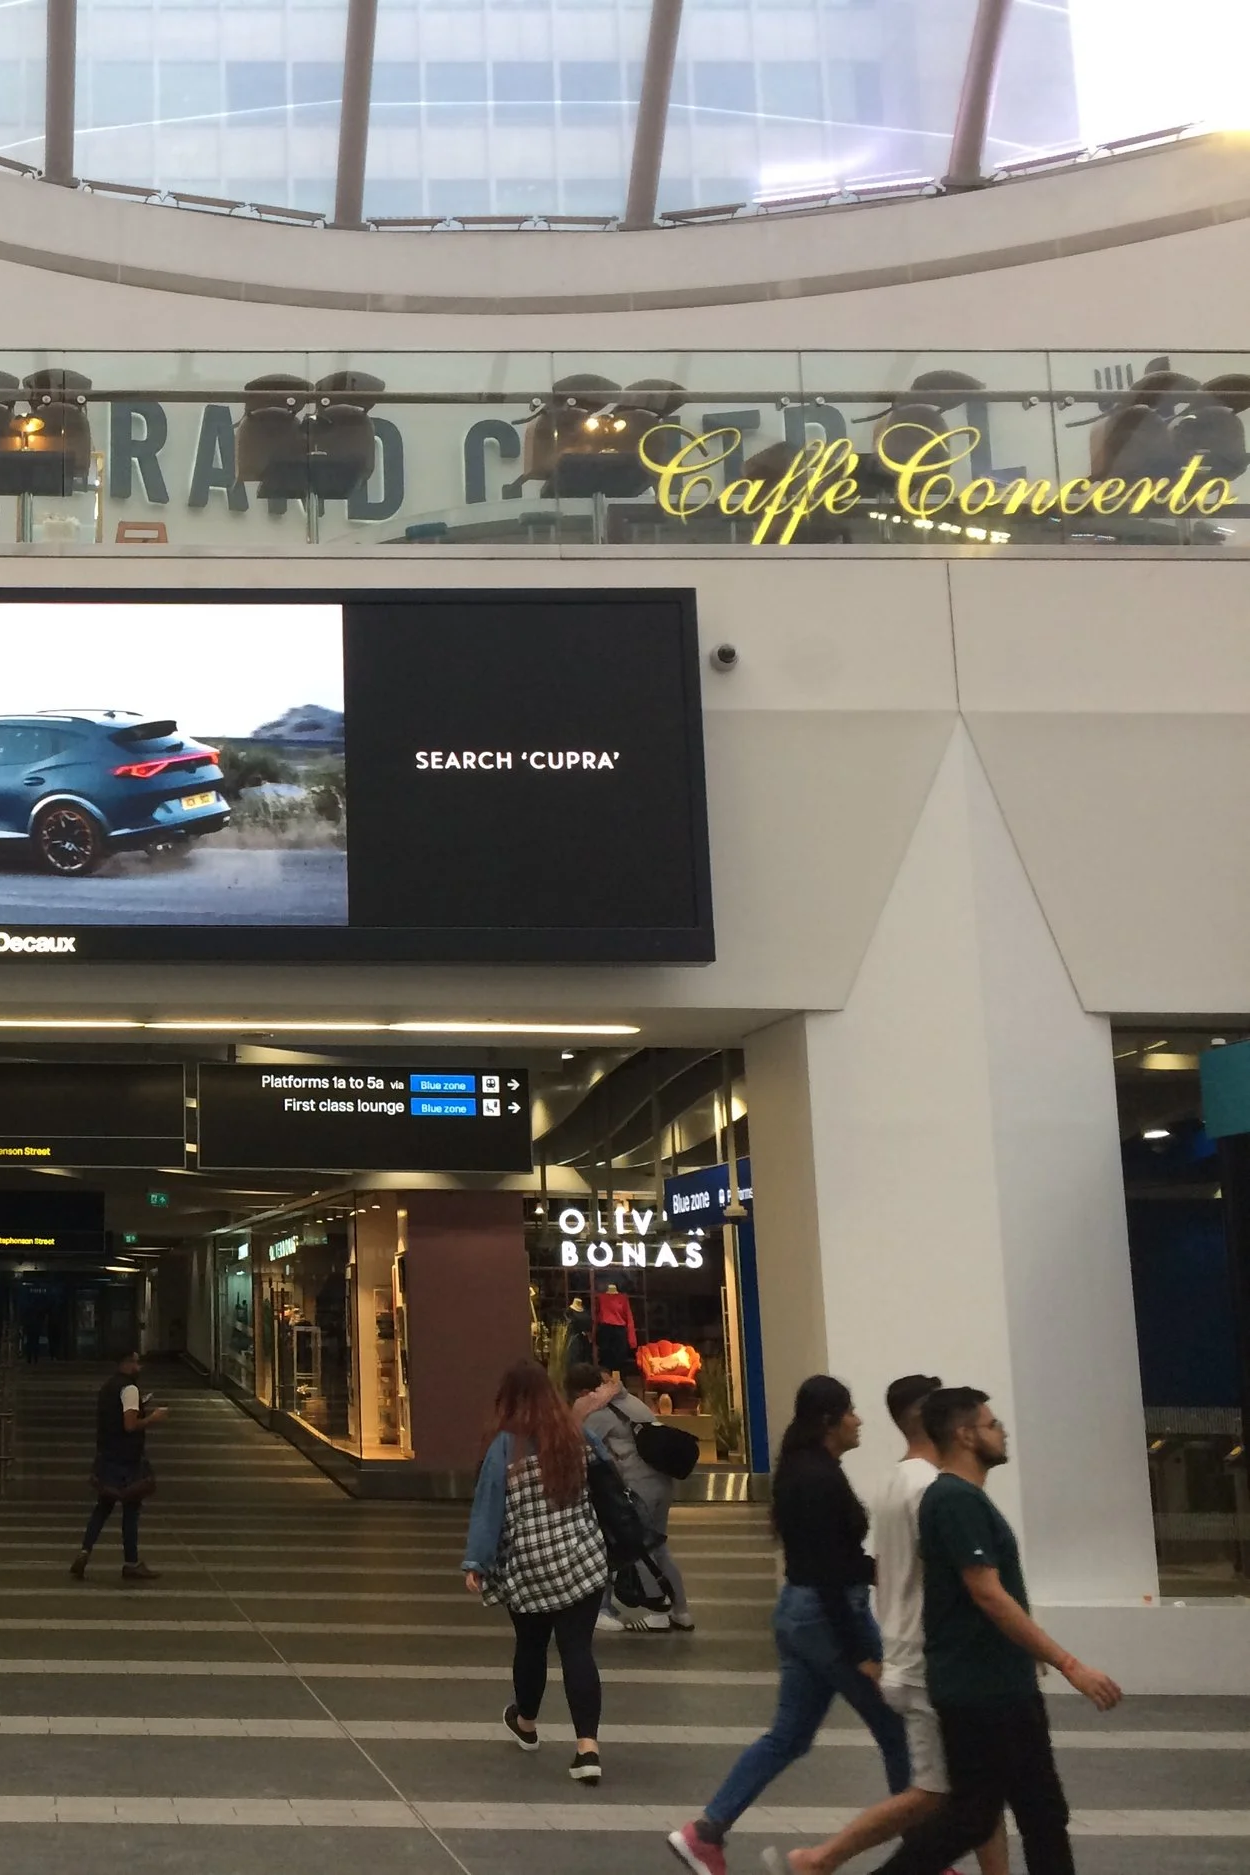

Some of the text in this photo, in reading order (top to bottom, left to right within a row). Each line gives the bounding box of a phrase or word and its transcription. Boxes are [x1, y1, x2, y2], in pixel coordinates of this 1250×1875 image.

[877, 422, 1239, 521] Concerto
[415, 751, 512, 770] SEARCH
[261, 1074, 405, 1091] Platforms 1a to 5a via
[420, 1080, 467, 1091] Blue zone
[284, 1098, 405, 1115] First class lounge
[421, 1103, 467, 1114] Blue zone
[24, 1146, 51, 1156] Street
[672, 1190, 710, 1215] Blue zone
[561, 1241, 704, 1269] BONAS
